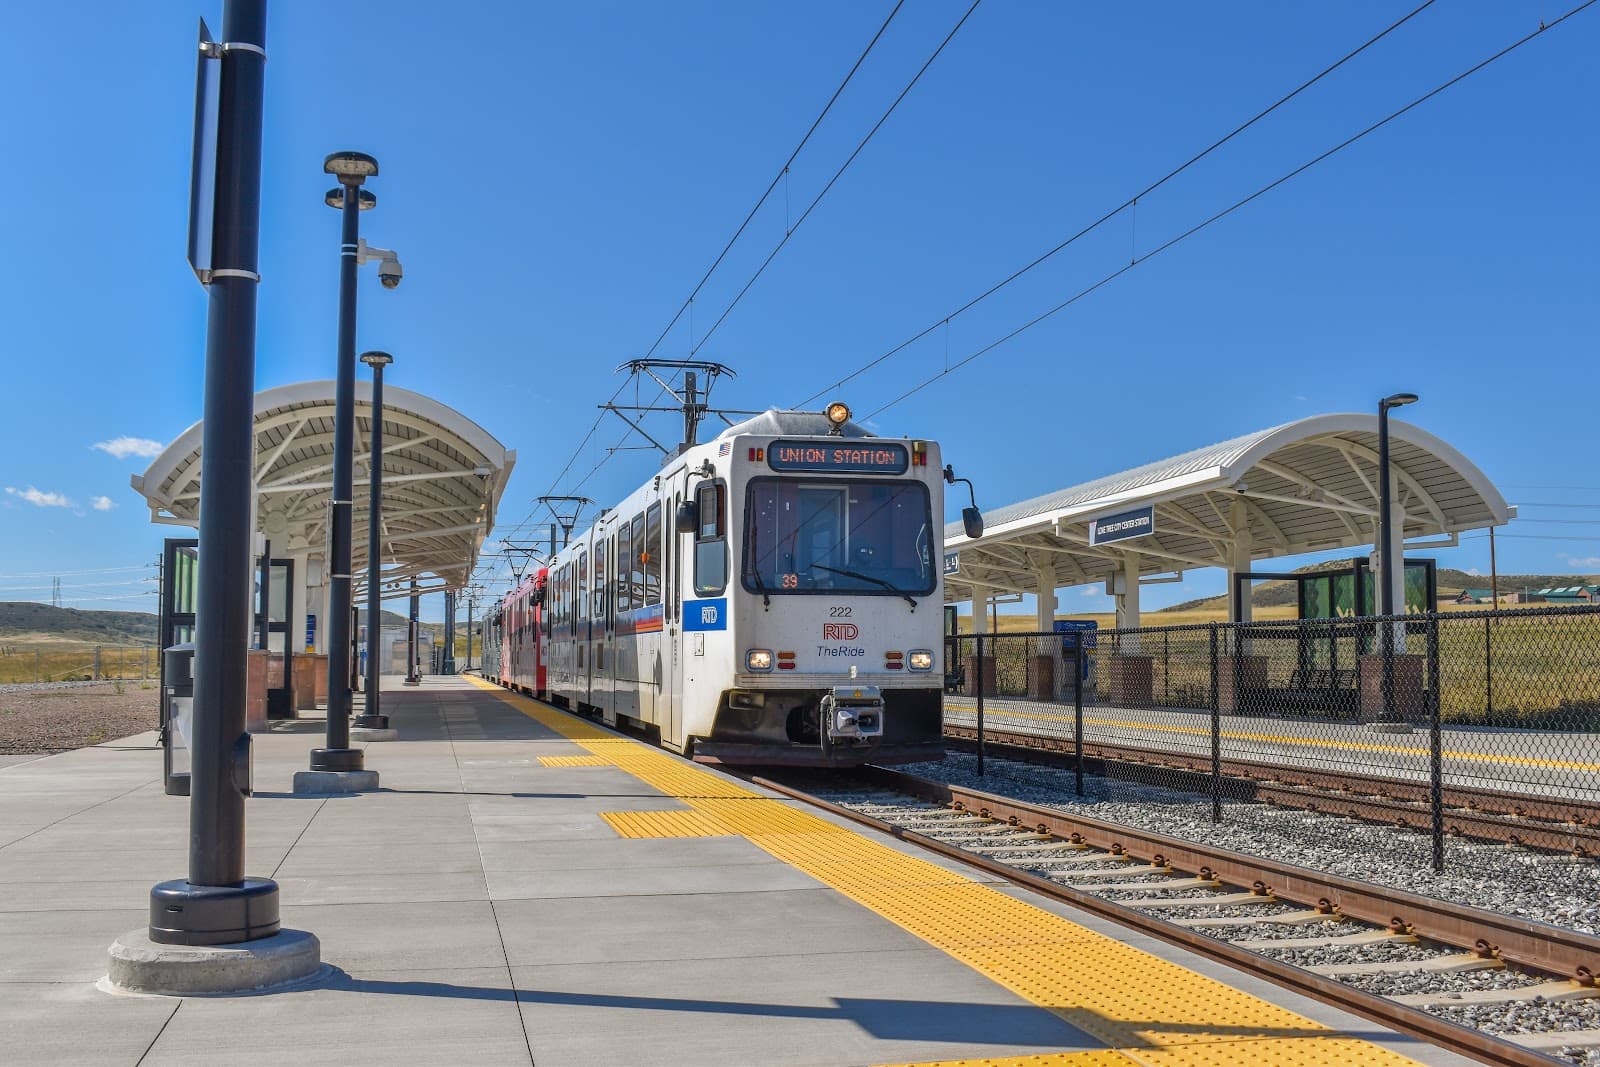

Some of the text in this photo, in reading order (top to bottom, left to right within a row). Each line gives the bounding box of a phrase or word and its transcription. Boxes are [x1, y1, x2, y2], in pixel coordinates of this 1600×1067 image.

[780, 447, 895, 465] UNION STATION
[783, 574, 798, 588] 39
[701, 606, 718, 624] RTD
[830, 606, 852, 618] 222
[823, 623, 859, 640] RTD
[817, 645, 865, 657] TheRide
